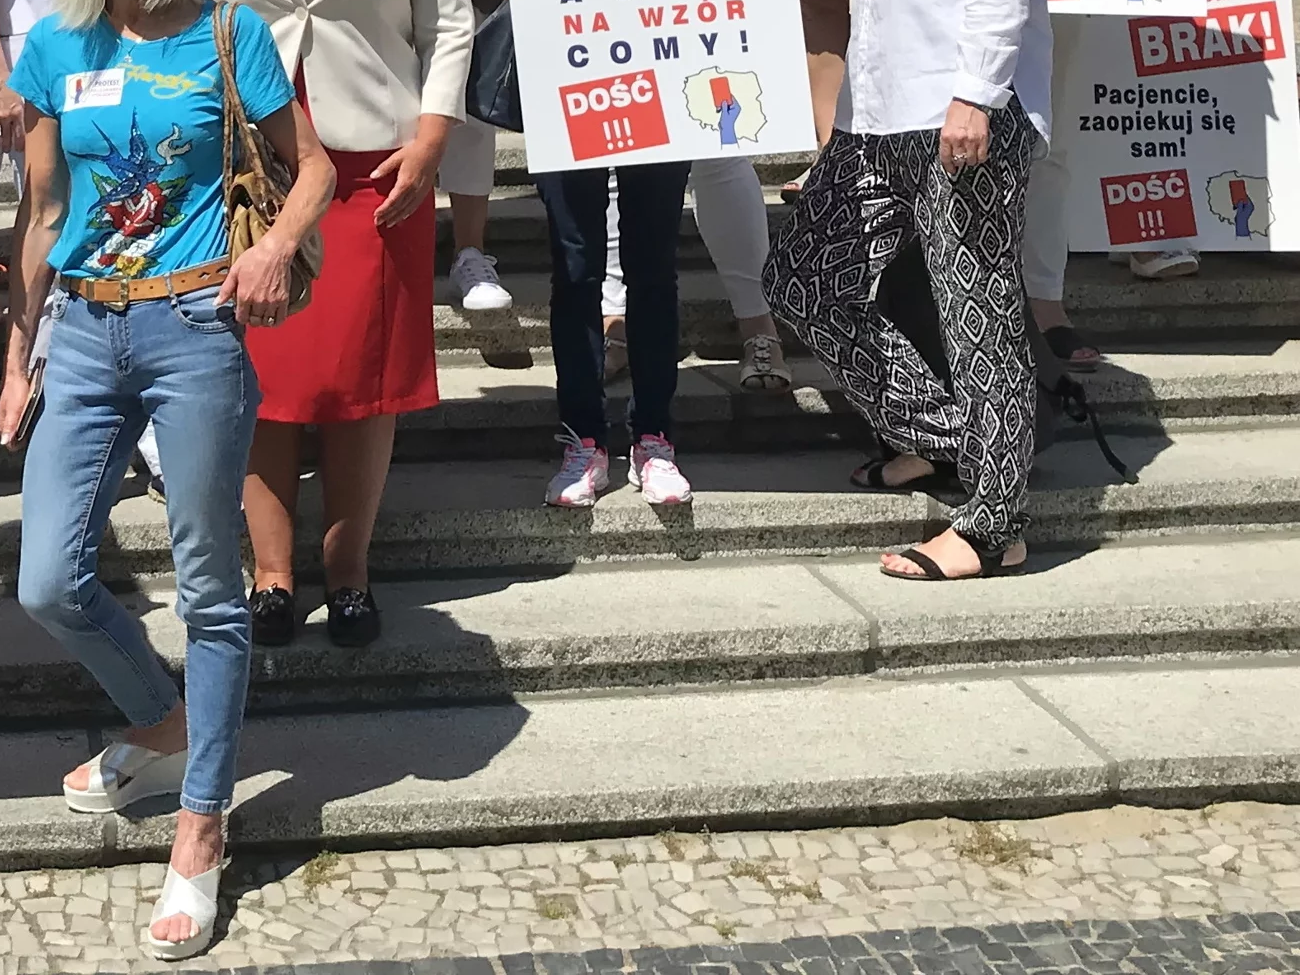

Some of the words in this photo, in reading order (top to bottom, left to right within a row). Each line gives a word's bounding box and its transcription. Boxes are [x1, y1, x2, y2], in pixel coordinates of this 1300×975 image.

[564, 13, 610, 34] NA
[1138, 11, 1277, 67] BRAK!
[566, 73, 654, 116] DOŚĆ
[1094, 84, 1218, 109] Pacjencie,
[603, 118, 634, 150] !!!
[1079, 111, 1193, 134] zaopiekuj
[1201, 112, 1235, 134] się
[1131, 137, 1187, 158] sam!
[1106, 172, 1185, 205] DOŚĆ
[1138, 209, 1165, 238] !!!
